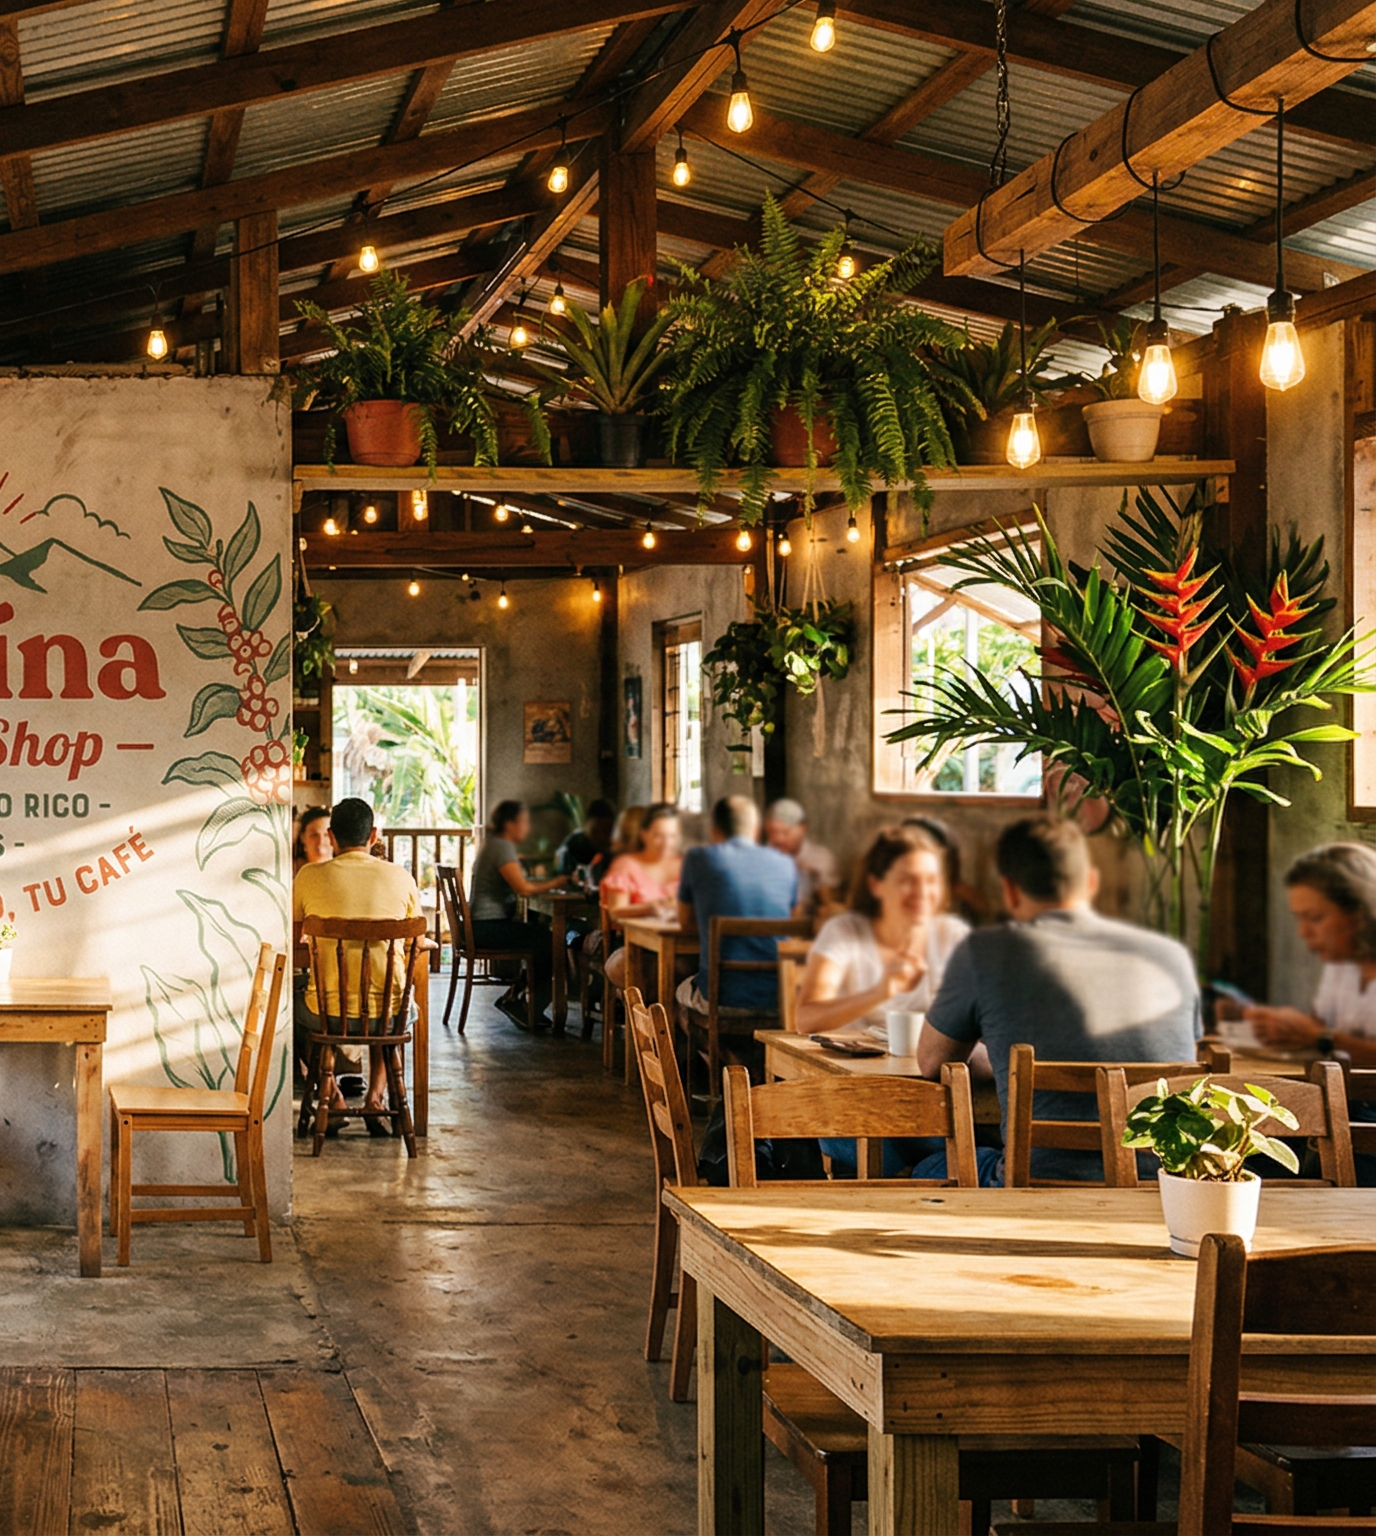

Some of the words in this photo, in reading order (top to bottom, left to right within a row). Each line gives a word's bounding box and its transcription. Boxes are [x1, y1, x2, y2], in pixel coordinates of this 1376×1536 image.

[24, 793, 91, 819] RICO
[22, 876, 67, 914] TU
[74, 825, 155, 896] CAFÉ
